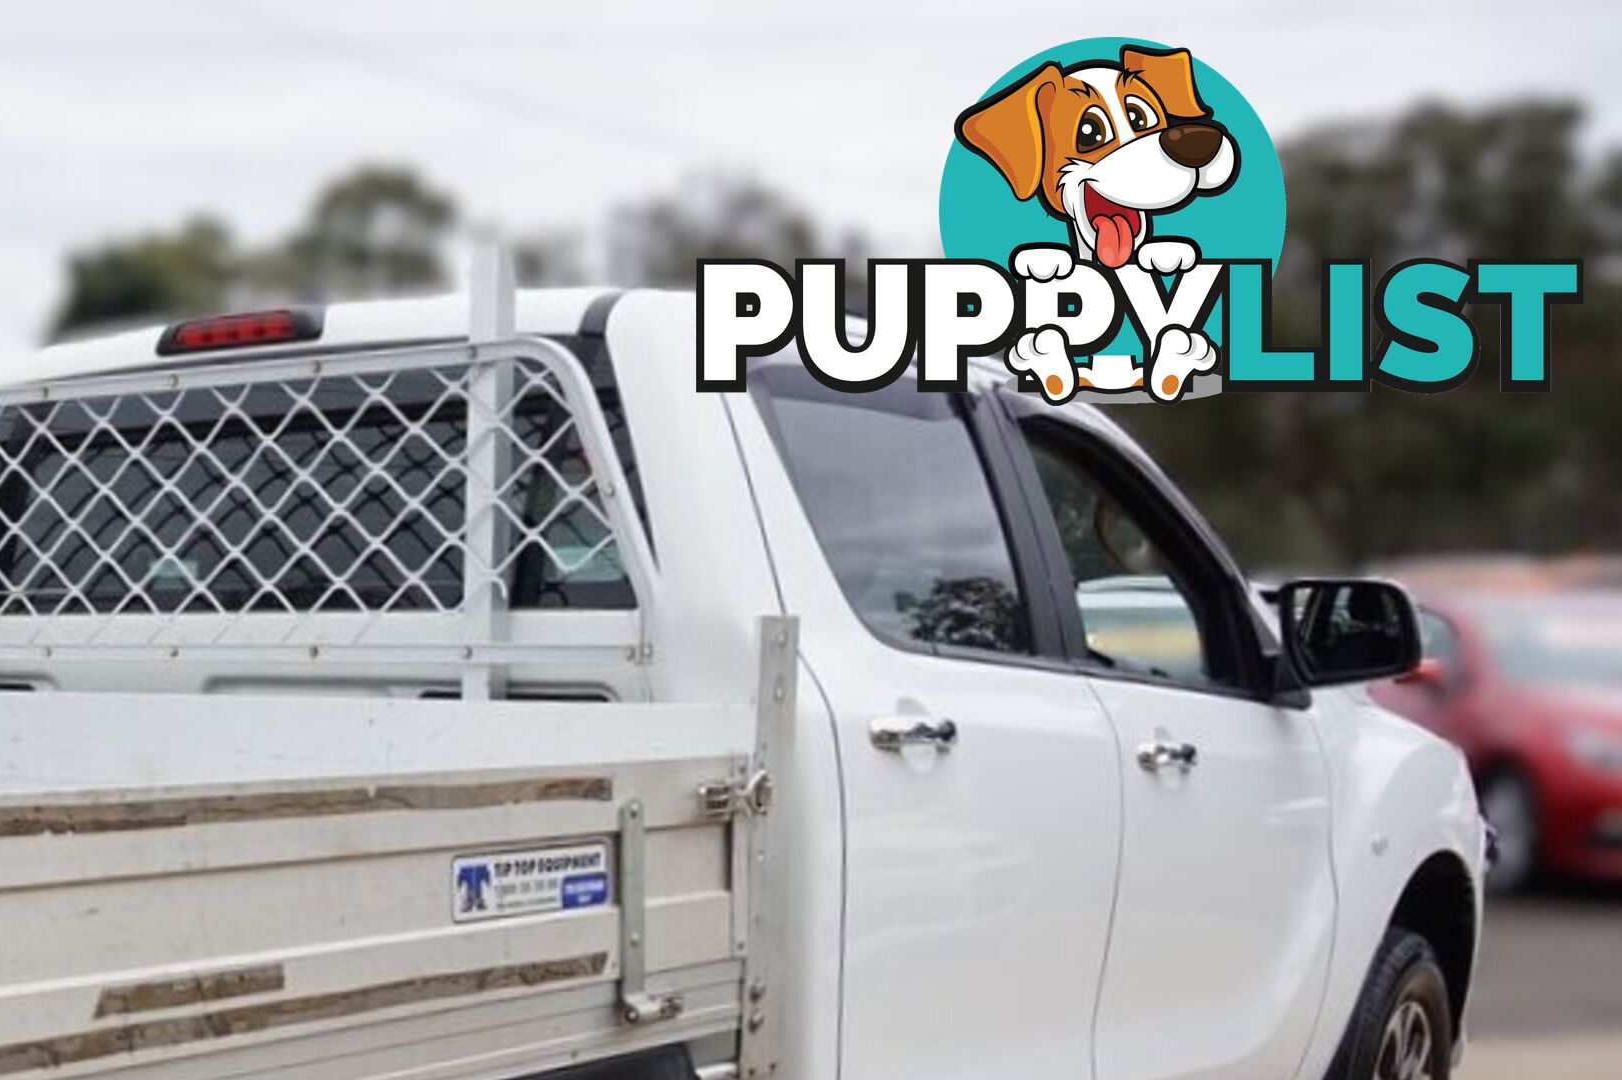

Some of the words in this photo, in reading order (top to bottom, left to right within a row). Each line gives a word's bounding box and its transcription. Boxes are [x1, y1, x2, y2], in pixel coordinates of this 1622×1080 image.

[494, 861, 512, 878] TIP
[515, 858, 537, 876] TOP
[538, 851, 602, 873] EQUIPMENT
